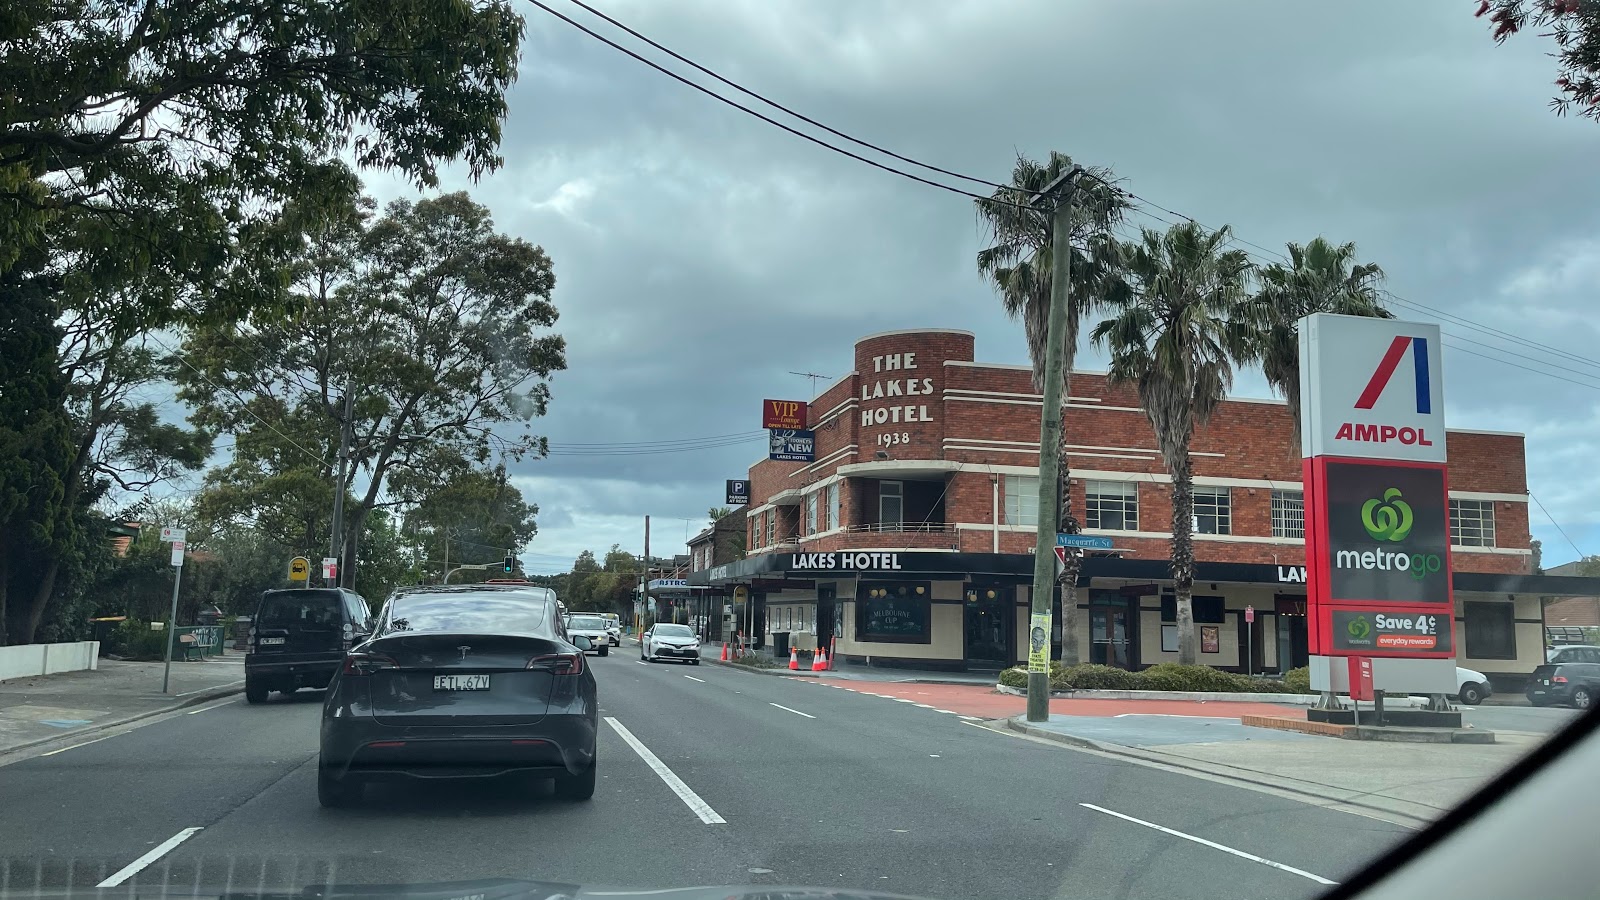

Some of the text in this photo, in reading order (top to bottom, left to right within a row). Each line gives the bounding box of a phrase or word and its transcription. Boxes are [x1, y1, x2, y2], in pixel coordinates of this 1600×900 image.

[872, 352, 918, 373] THE
[862, 378, 934, 401] LAKES
[771, 401, 799, 417] VIP
[861, 405, 934, 427] HOTEL
[877, 432, 910, 448] 1938
[1335, 423, 1433, 447] AMPOL
[788, 443, 813, 453] NEW
[734, 482, 743, 493] P
[1059, 536, 1110, 548] Macquarie St
[792, 552, 902, 570] LAKES HOTEL
[1336, 547, 1441, 580] metrogo
[873, 609, 911, 619] MELBOURNE
[885, 616, 898, 624] CUP
[1375, 614, 1413, 630] Save
[1379, 638, 1408, 646] everyday
